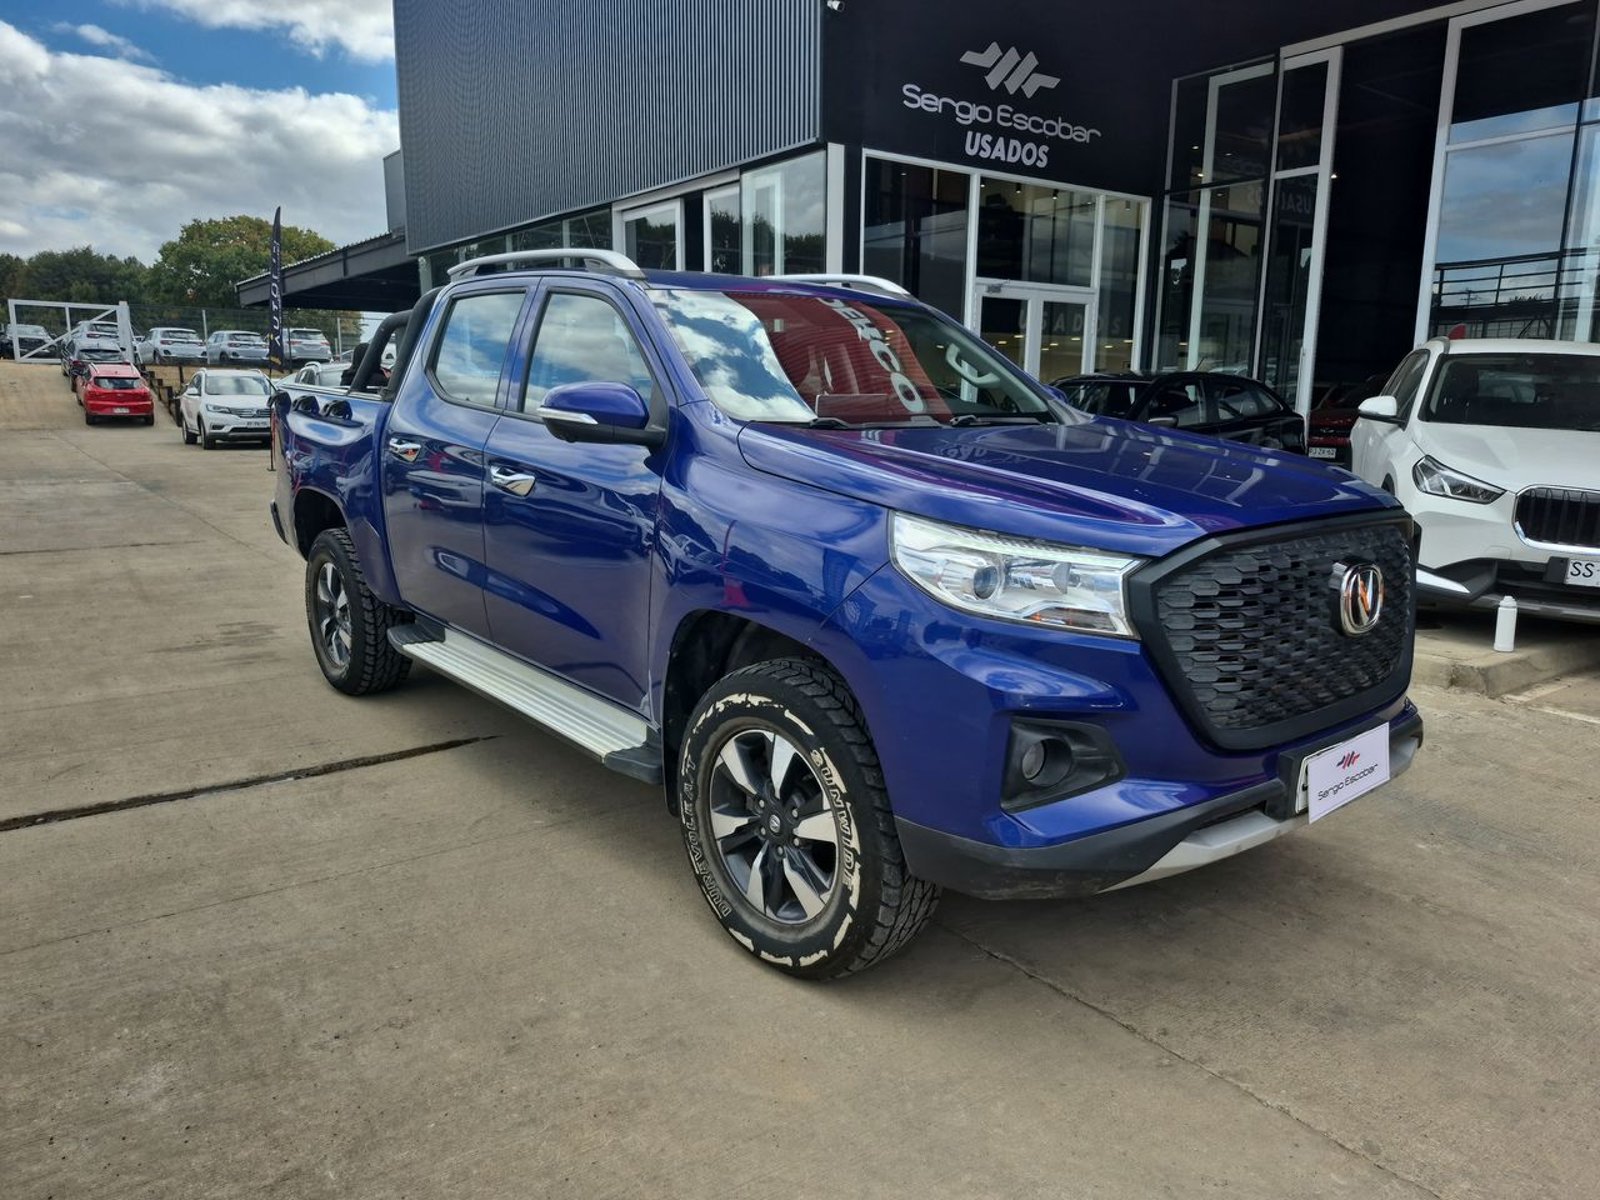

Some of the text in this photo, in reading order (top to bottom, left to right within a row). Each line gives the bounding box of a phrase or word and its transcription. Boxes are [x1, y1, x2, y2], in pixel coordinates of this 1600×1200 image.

[902, 83, 1101, 143] Sergio Escobar
[964, 130, 1050, 168] USADOS
[1318, 763, 1378, 801] Sergio Escobar
[809, 748, 855, 890] SUNWIDE
